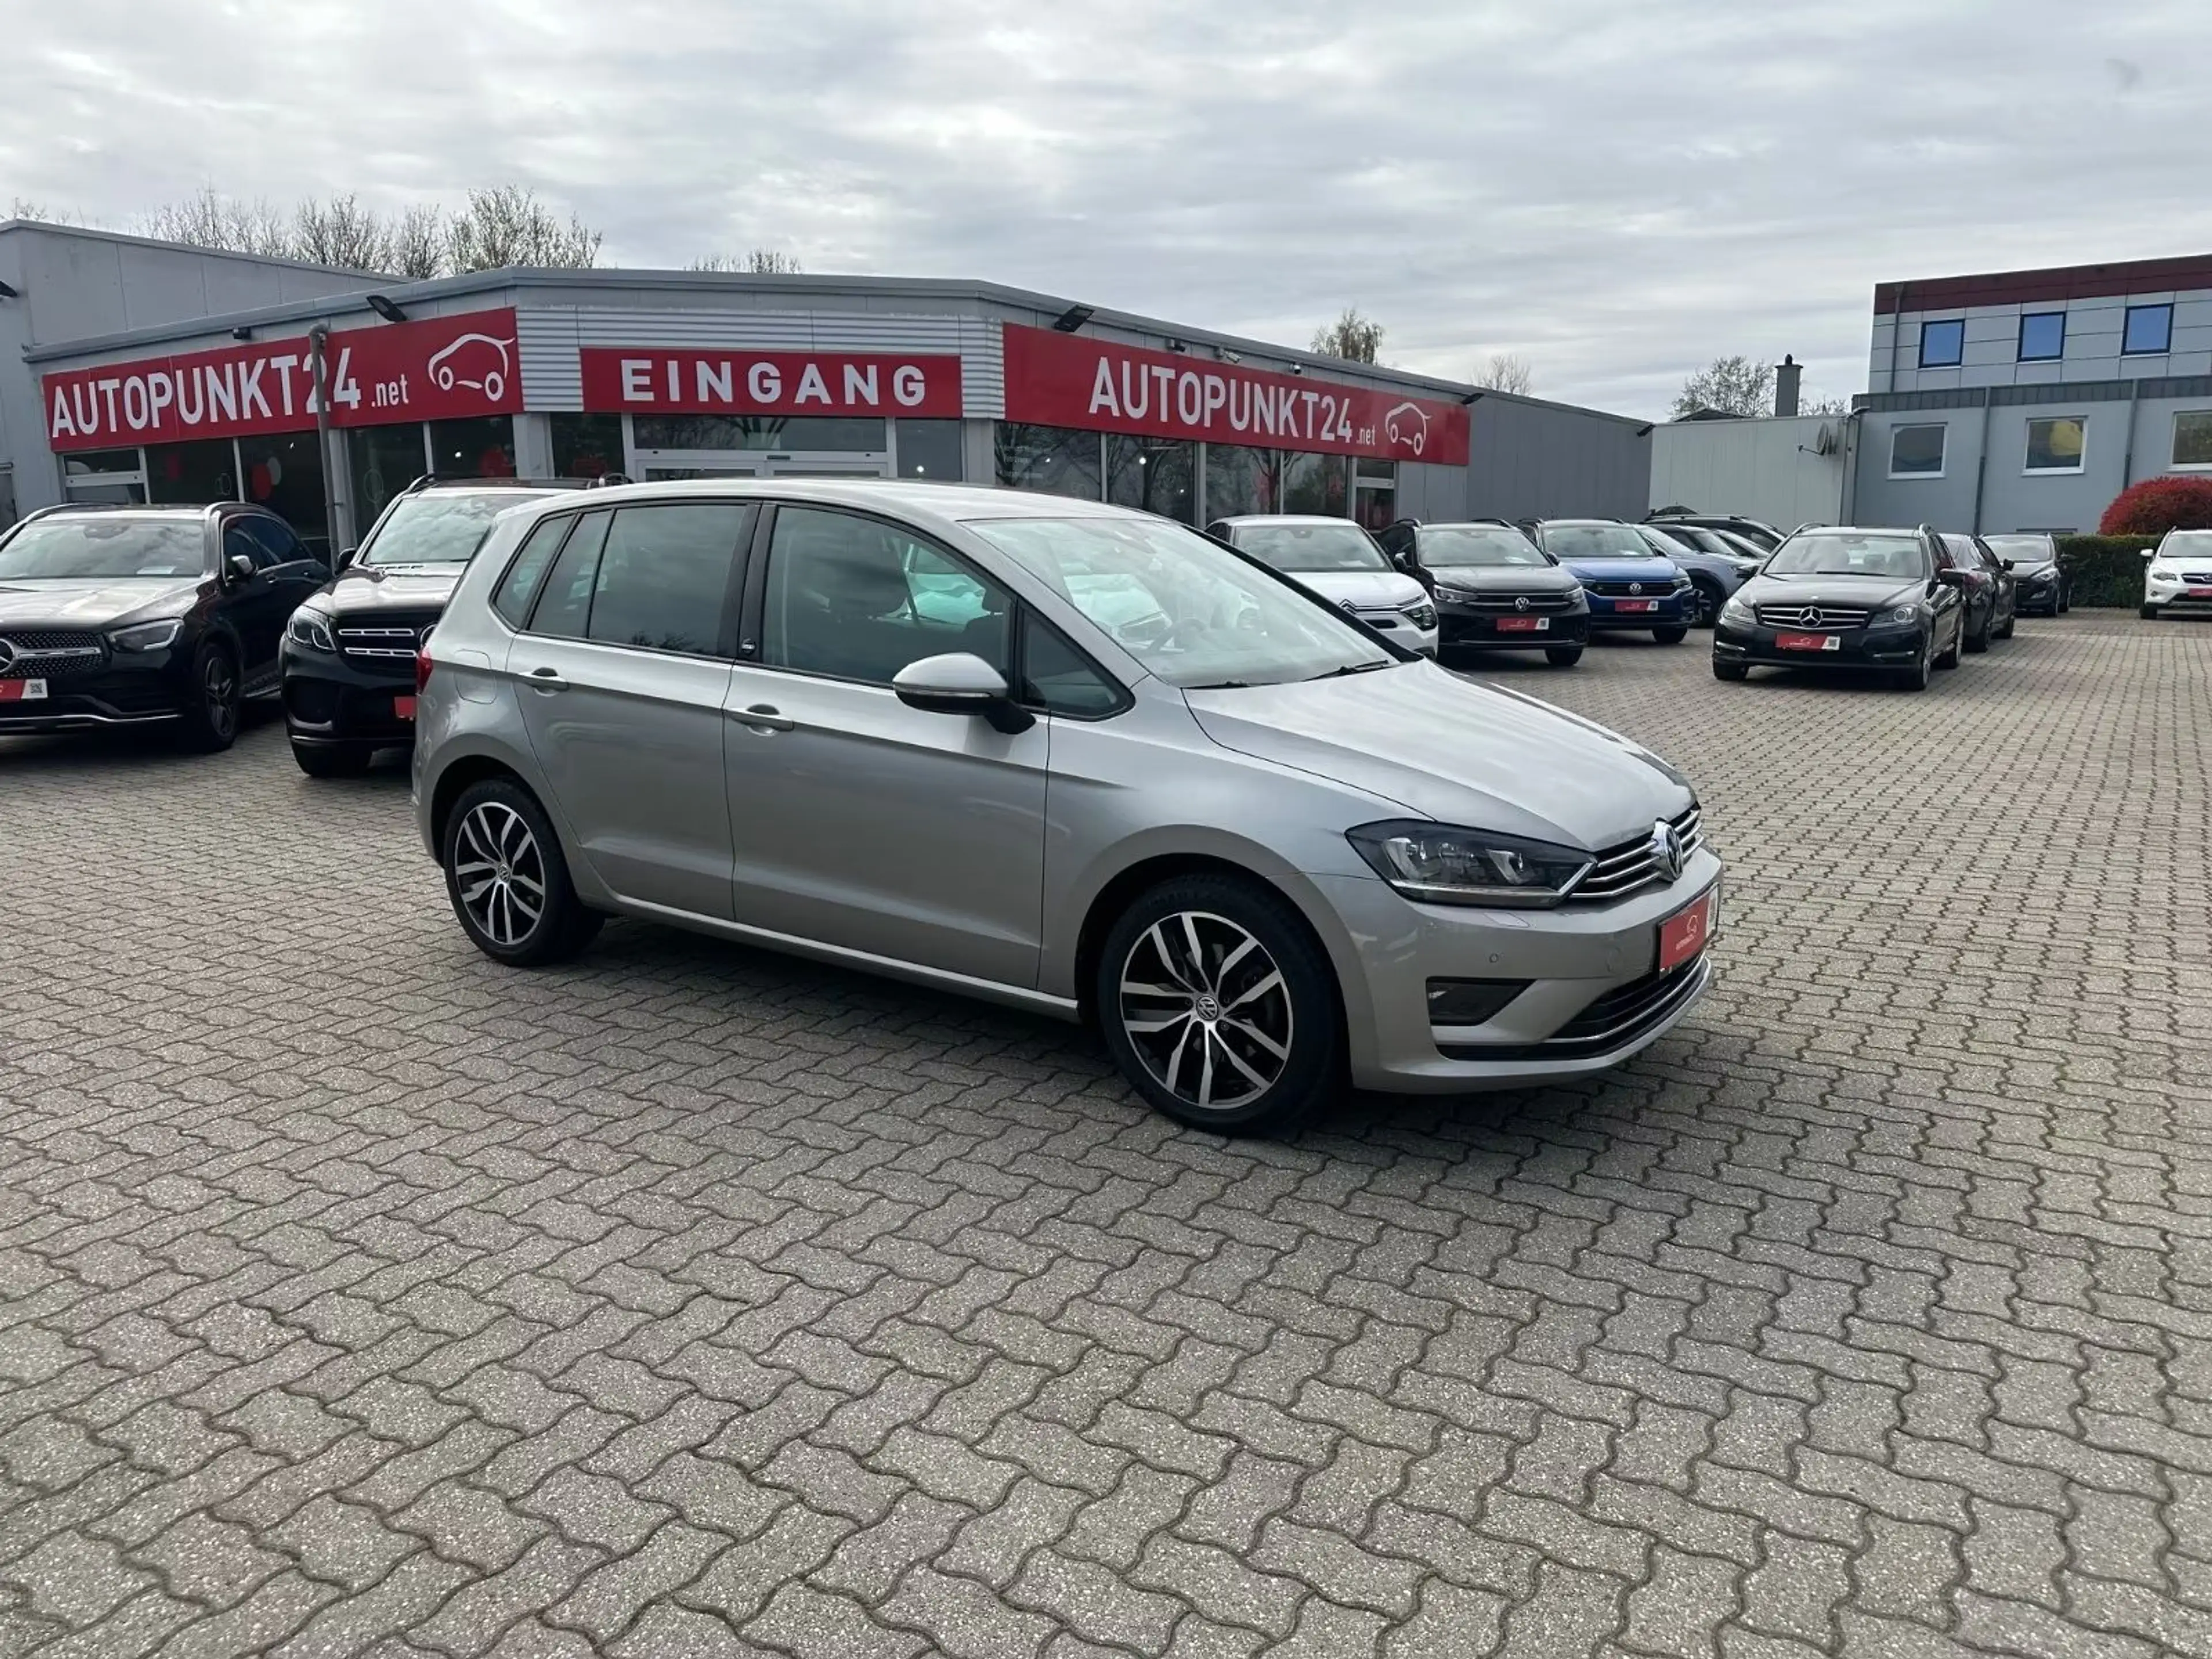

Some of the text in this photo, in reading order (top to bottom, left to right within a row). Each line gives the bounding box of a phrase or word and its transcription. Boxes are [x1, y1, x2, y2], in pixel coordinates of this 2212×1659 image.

[52, 347, 409, 437] AUTOPUNKT24 .net
[622, 359, 925, 406] EINGANG
[1089, 357, 1377, 445] AUTOPUNKT24 .net
